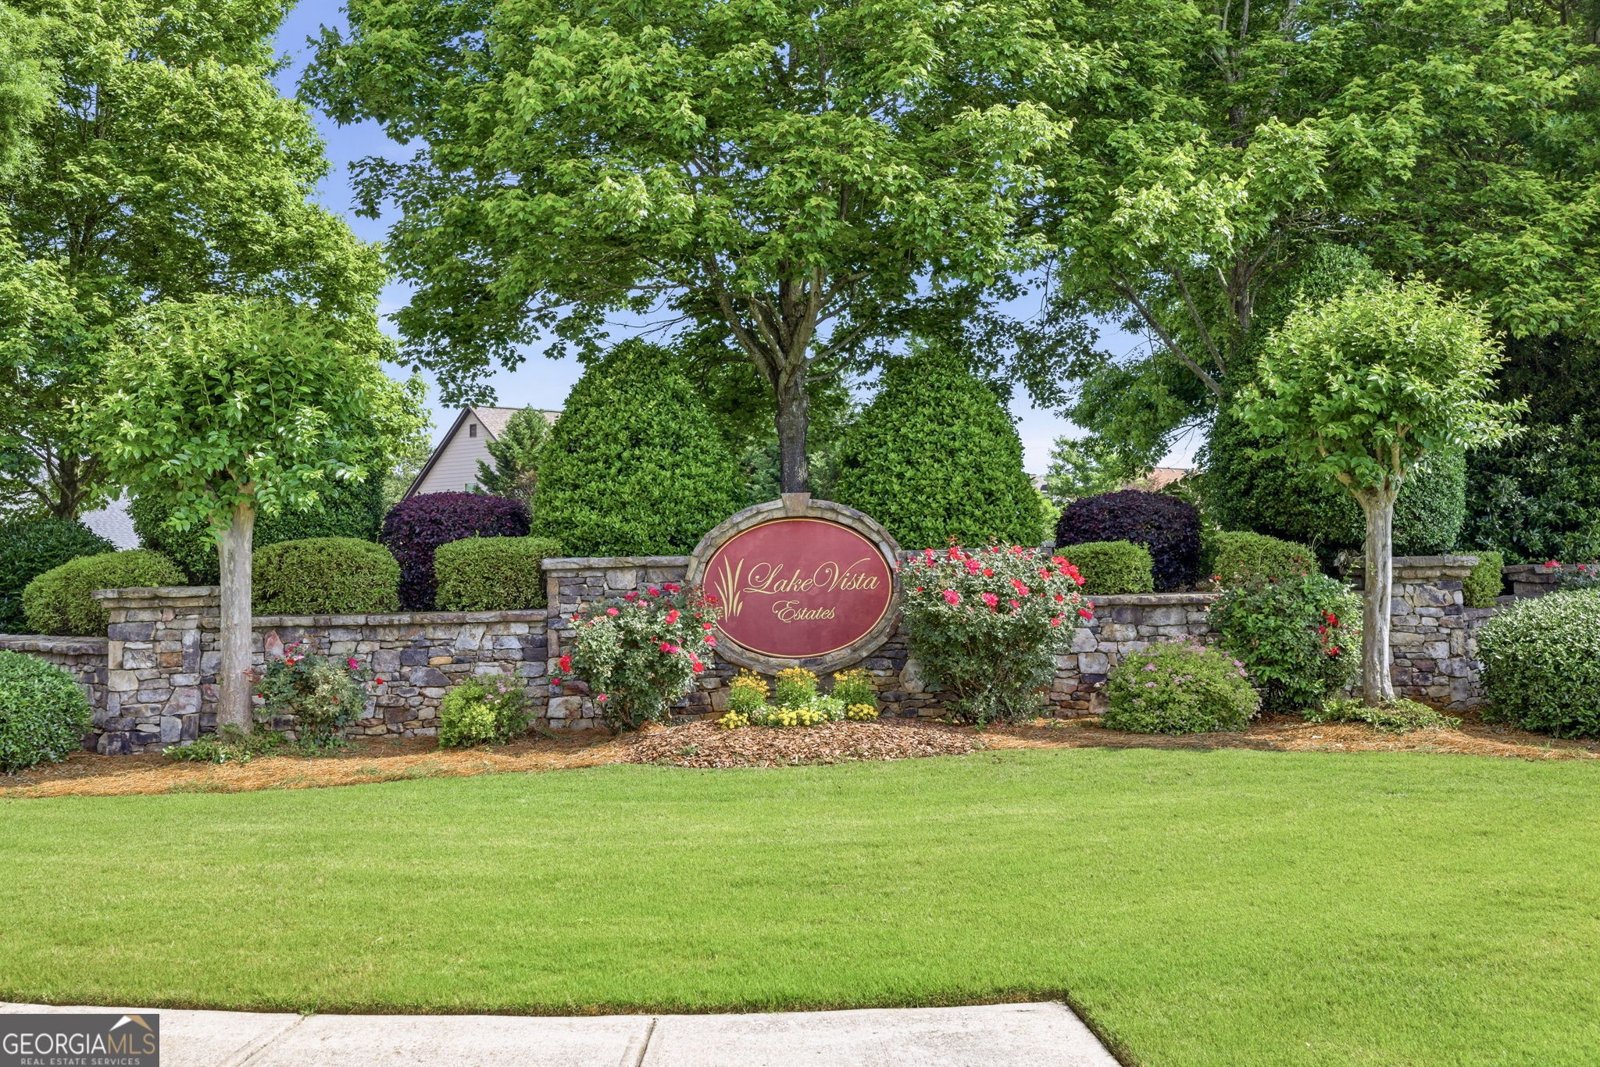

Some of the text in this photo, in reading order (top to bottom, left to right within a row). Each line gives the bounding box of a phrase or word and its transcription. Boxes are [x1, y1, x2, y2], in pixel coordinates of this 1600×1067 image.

[743, 558, 880, 594] Lake Vista
[772, 600, 836, 623] Estates
